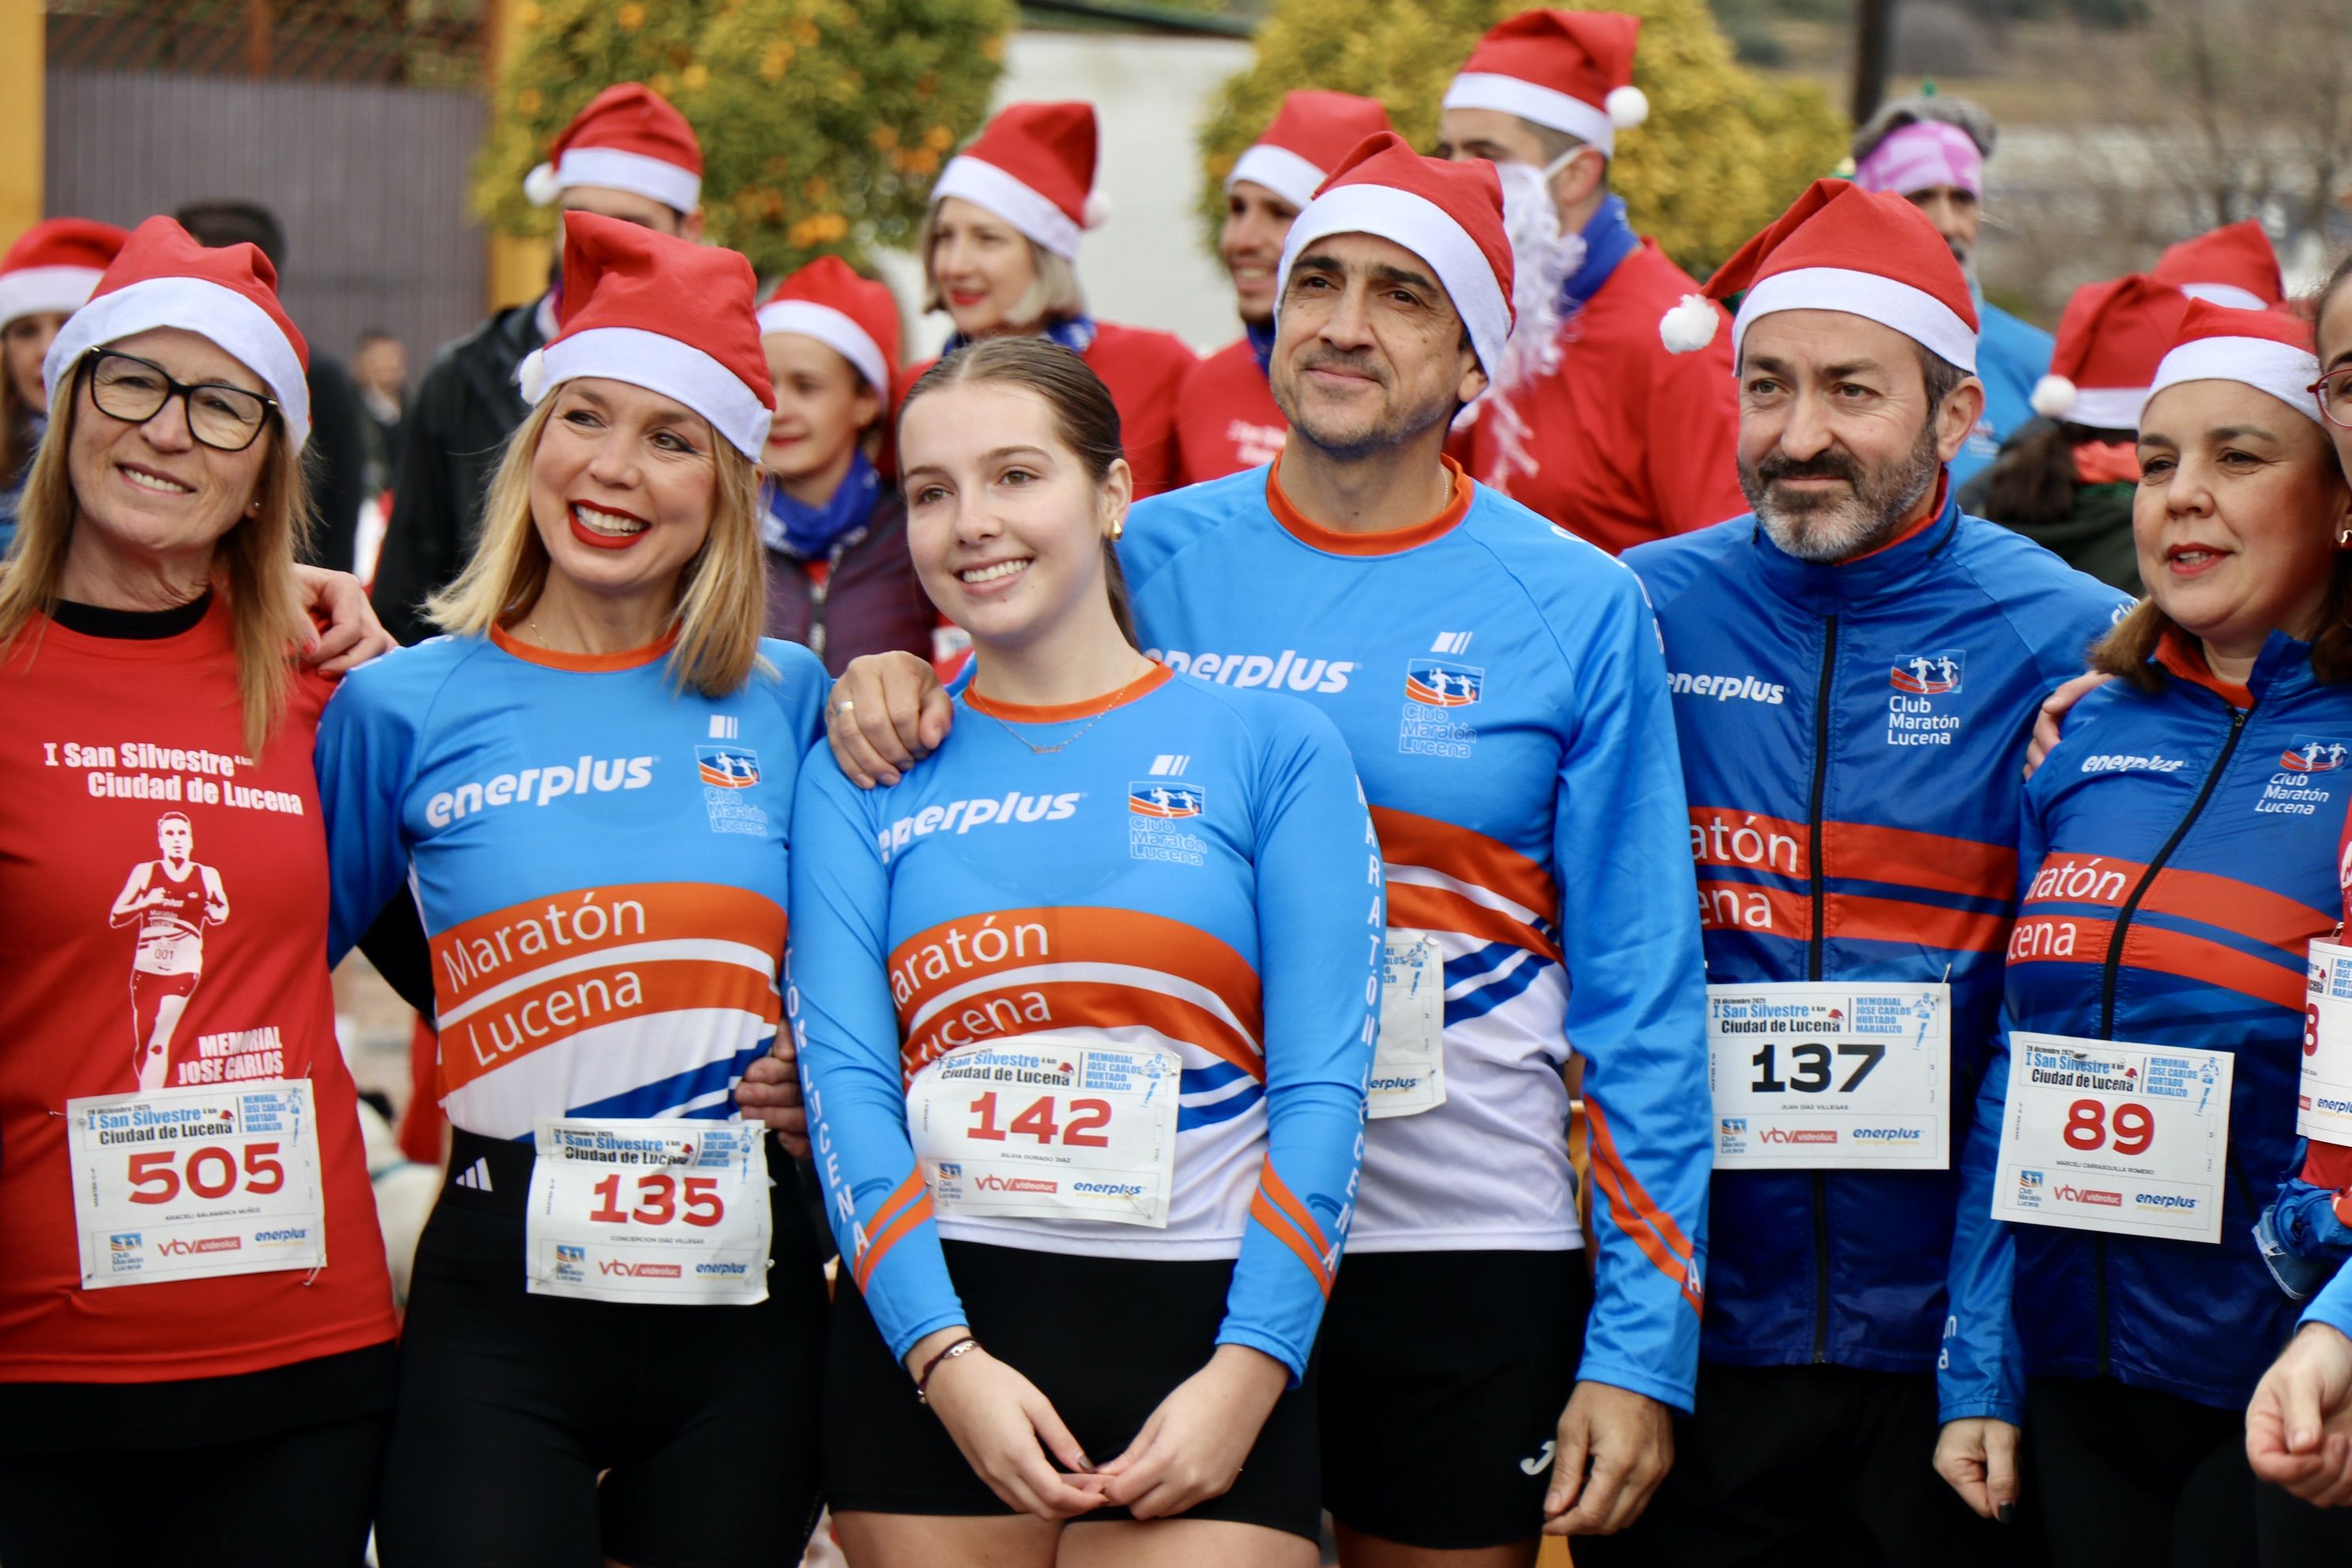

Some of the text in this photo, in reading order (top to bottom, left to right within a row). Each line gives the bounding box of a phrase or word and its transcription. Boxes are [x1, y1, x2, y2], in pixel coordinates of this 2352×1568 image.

[1403, 703, 1449, 722] Club
[1889, 695, 1932, 714] Club
[1888, 714, 1960, 729] Maratón
[1401, 720, 1477, 743] Maratón
[1886, 729, 1951, 745] Lucena
[1399, 735, 1471, 759] Lucena
[44, 743, 58, 767] I
[64, 743, 115, 767] San
[121, 743, 235, 777] Silvestre
[2081, 753, 2184, 773] enerplus
[2270, 773, 2309, 786] Club
[88, 771, 303, 816] Ciudad de Lucena
[426, 755, 652, 827] enerplus
[2263, 785, 2330, 802] Maratón
[2254, 799, 2316, 815] Lucena
[1129, 816, 1175, 833] Club
[1131, 831, 1208, 854] Maratón
[1690, 815, 1797, 873] atón
[1131, 843, 1203, 865] Lucena
[442, 891, 646, 993] Maratón
[2007, 922, 2077, 962] cena
[891, 915, 1049, 1011] aratón
[1856, 997, 1902, 1006] MEMORIAL
[468, 970, 643, 1067] Lucena
[1723, 1004, 1747, 1018] San
[1751, 1004, 1809, 1018] Silvestre
[1856, 1016, 1897, 1024] HURTADO
[1878, 1007, 1912, 1016] CARLOS
[1721, 1020, 1840, 1033] Ciudad de Lucena
[198, 1026, 283, 1057] MEMORIAL
[178, 1050, 284, 1084] JOSE CARLOS
[947, 1057, 971, 1069] San
[974, 1053, 1039, 1067] Silvestre
[1088, 1052, 1133, 1064] MEMORIAL
[2034, 1053, 2056, 1069] San
[2150, 1057, 2189, 1069] MEMORIAL
[994, 1068, 1012, 1080] de
[1016, 1069, 1070, 1086] Lucena
[1087, 1062, 1143, 1075] JOSE CARLOS
[1087, 1071, 1127, 1082] HURTADO
[1751, 1043, 1886, 1093] 137
[2150, 1067, 2198, 1079] JOSE CARLOS
[1370, 1077, 1416, 1090] erplus
[2032, 1069, 2134, 1092] Ciudad de Lucena
[100, 1114, 129, 1129] San
[134, 1108, 201, 1125] Silvestre
[967, 1091, 1113, 1148] 142
[2064, 1099, 2154, 1155] 89
[100, 1123, 232, 1145] Ciudad de Lucena
[565, 1134, 593, 1148] San
[597, 1136, 663, 1152] Silvestre
[1853, 1128, 1920, 1140] enerplus
[620, 1152, 639, 1163] de
[128, 1142, 285, 1204] 505
[590, 1174, 724, 1227] 135
[2135, 1193, 2196, 1208] enerplus
[255, 1228, 306, 1242] enerplus
[695, 1263, 747, 1275] enerplus
